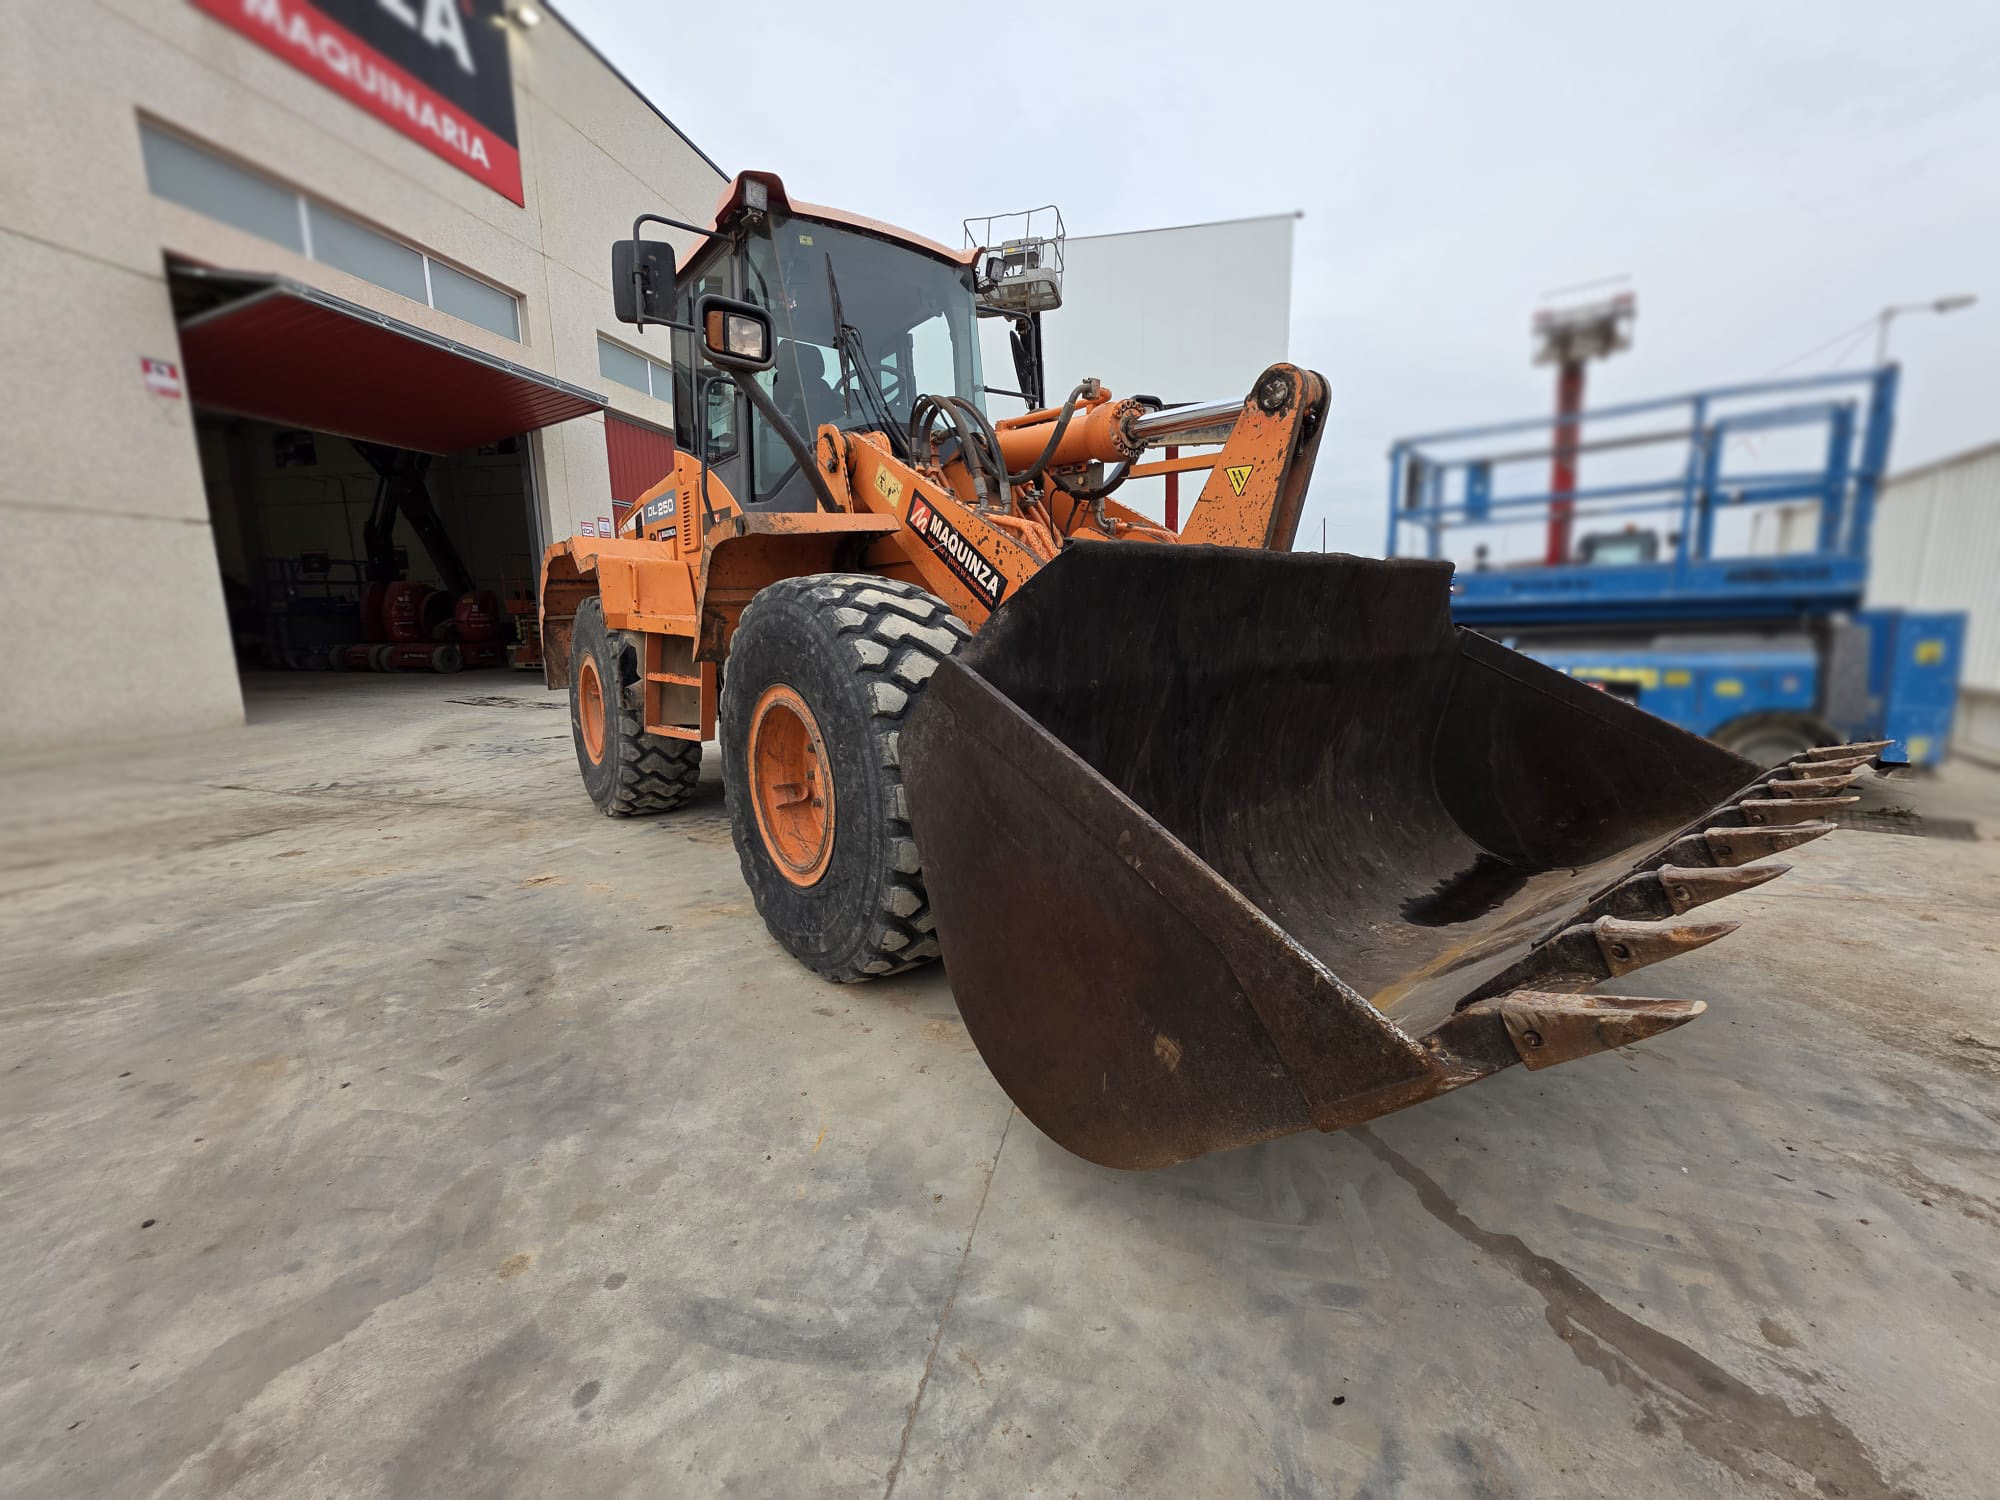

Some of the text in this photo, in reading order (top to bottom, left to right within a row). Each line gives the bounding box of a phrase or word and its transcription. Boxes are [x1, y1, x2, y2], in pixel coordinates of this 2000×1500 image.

[243, 0, 490, 169] MAQUINARIA
[647, 498, 674, 517] DL 250
[929, 514, 999, 597] MAQUINZA
